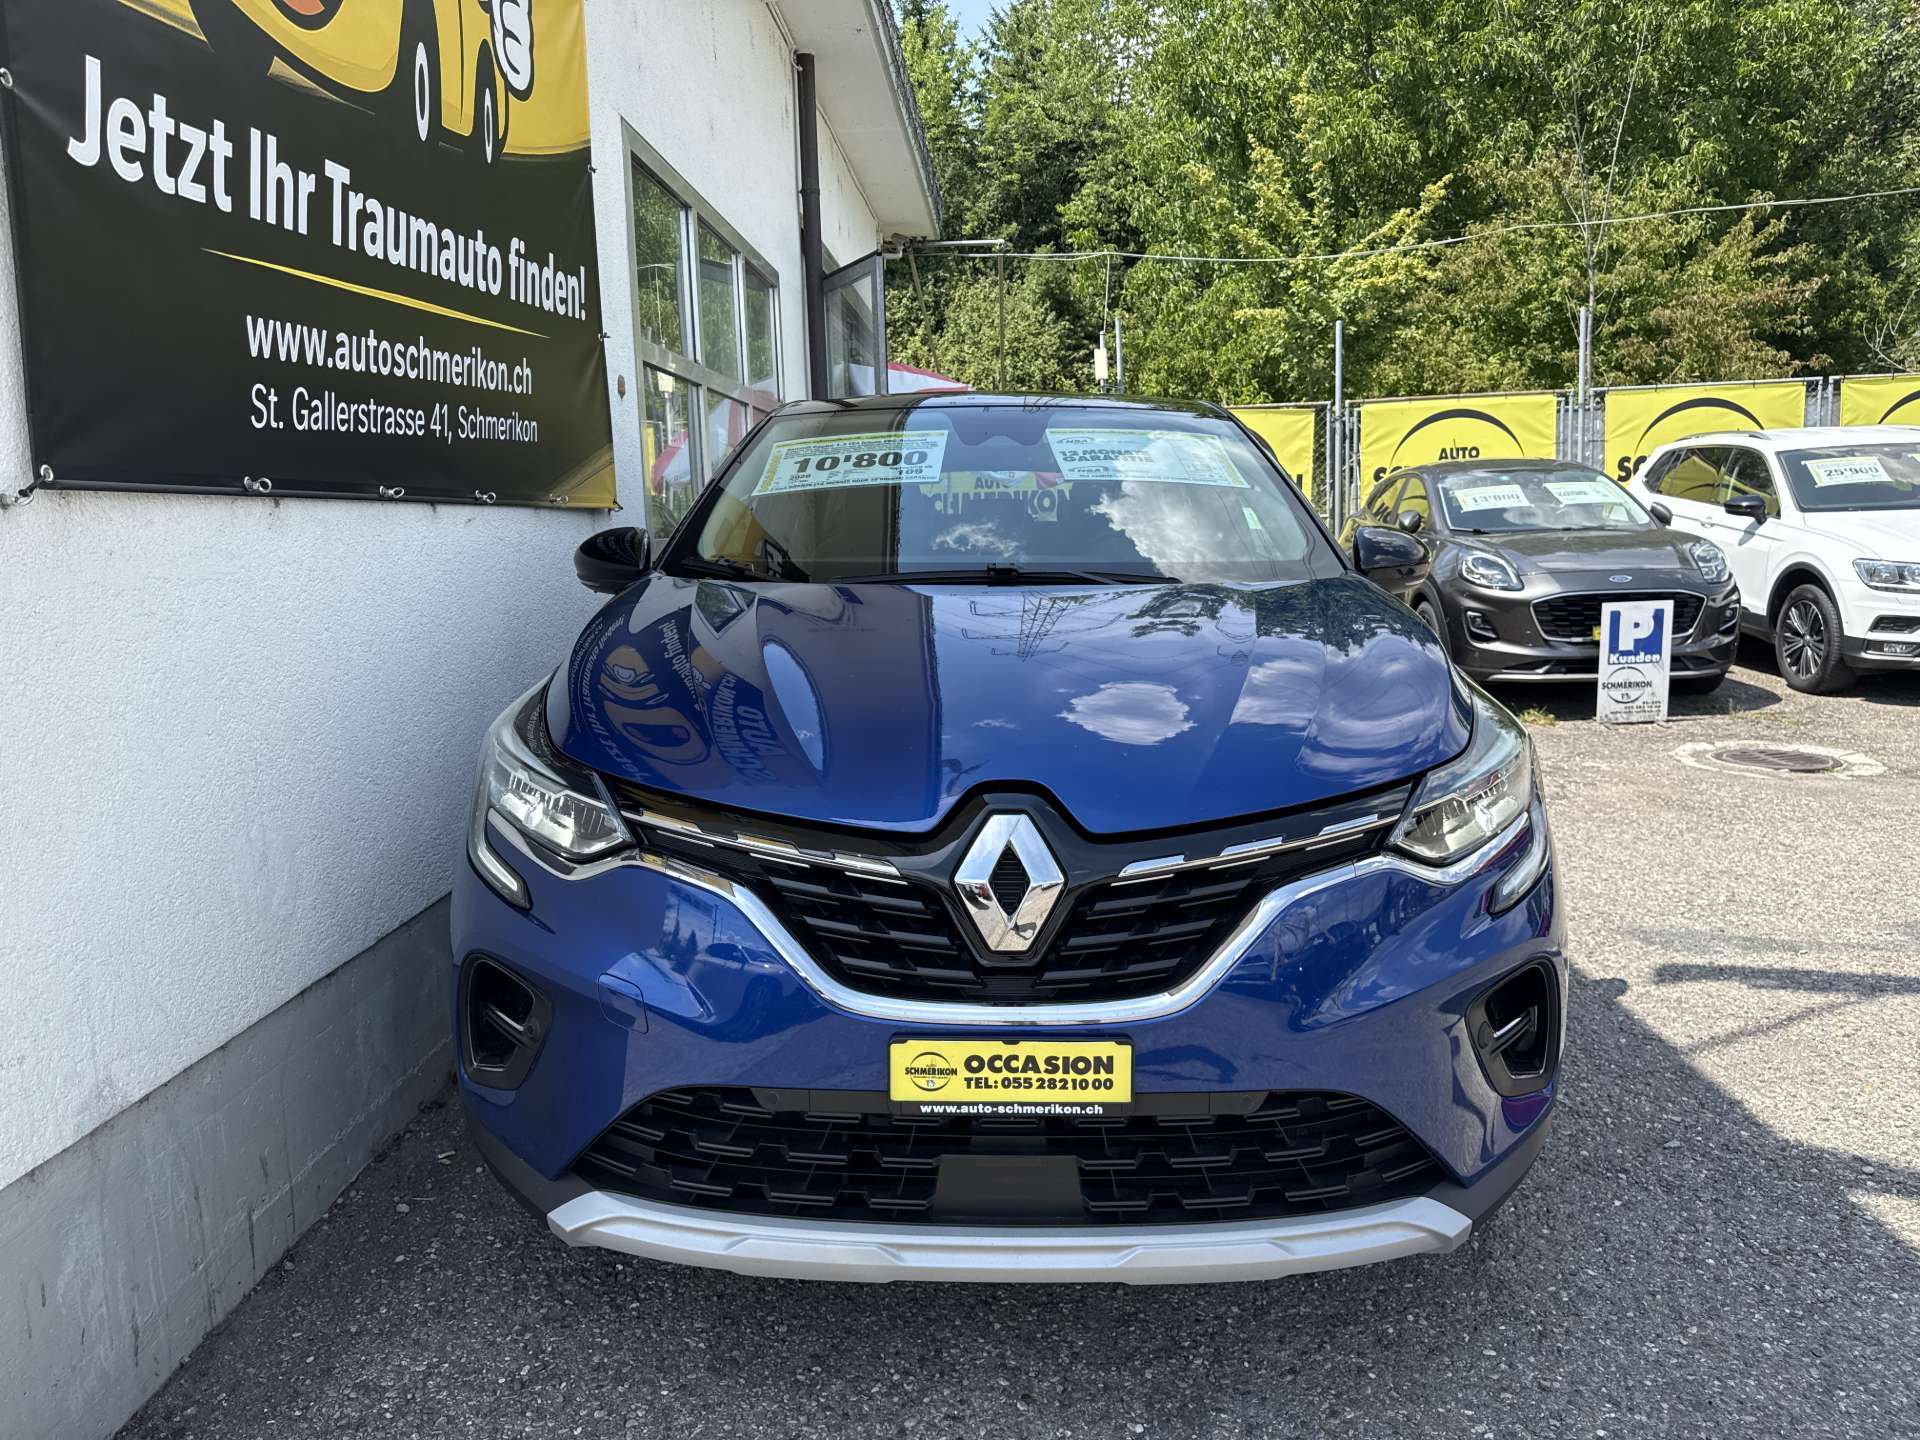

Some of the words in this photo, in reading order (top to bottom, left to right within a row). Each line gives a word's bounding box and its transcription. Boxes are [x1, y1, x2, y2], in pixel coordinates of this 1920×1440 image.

[67, 54, 233, 212] Jetzt
[249, 127, 316, 235] Ihr
[324, 158, 502, 295] Traumauto
[508, 237, 586, 320] finden!
[246, 315, 532, 395] www.autoschmerikon.ch
[250, 383, 284, 430] St.
[291, 387, 426, 437] Gallerstrasse
[429, 402, 452, 445] 41,
[457, 407, 538, 443] Schmerikon
[1437, 446, 1480, 461] AUTO
[794, 450, 928, 473] 10'800
[1824, 465, 1880, 477] 25'900
[1608, 652, 1661, 664] Kunden
[1602, 680, 1652, 690] SCHMERIKON
[904, 1067, 958, 1076] SCHMERIKON
[964, 1054, 1114, 1075] OCCASION
[920, 1103, 1104, 1115] www.auto-schmerikon.ch
